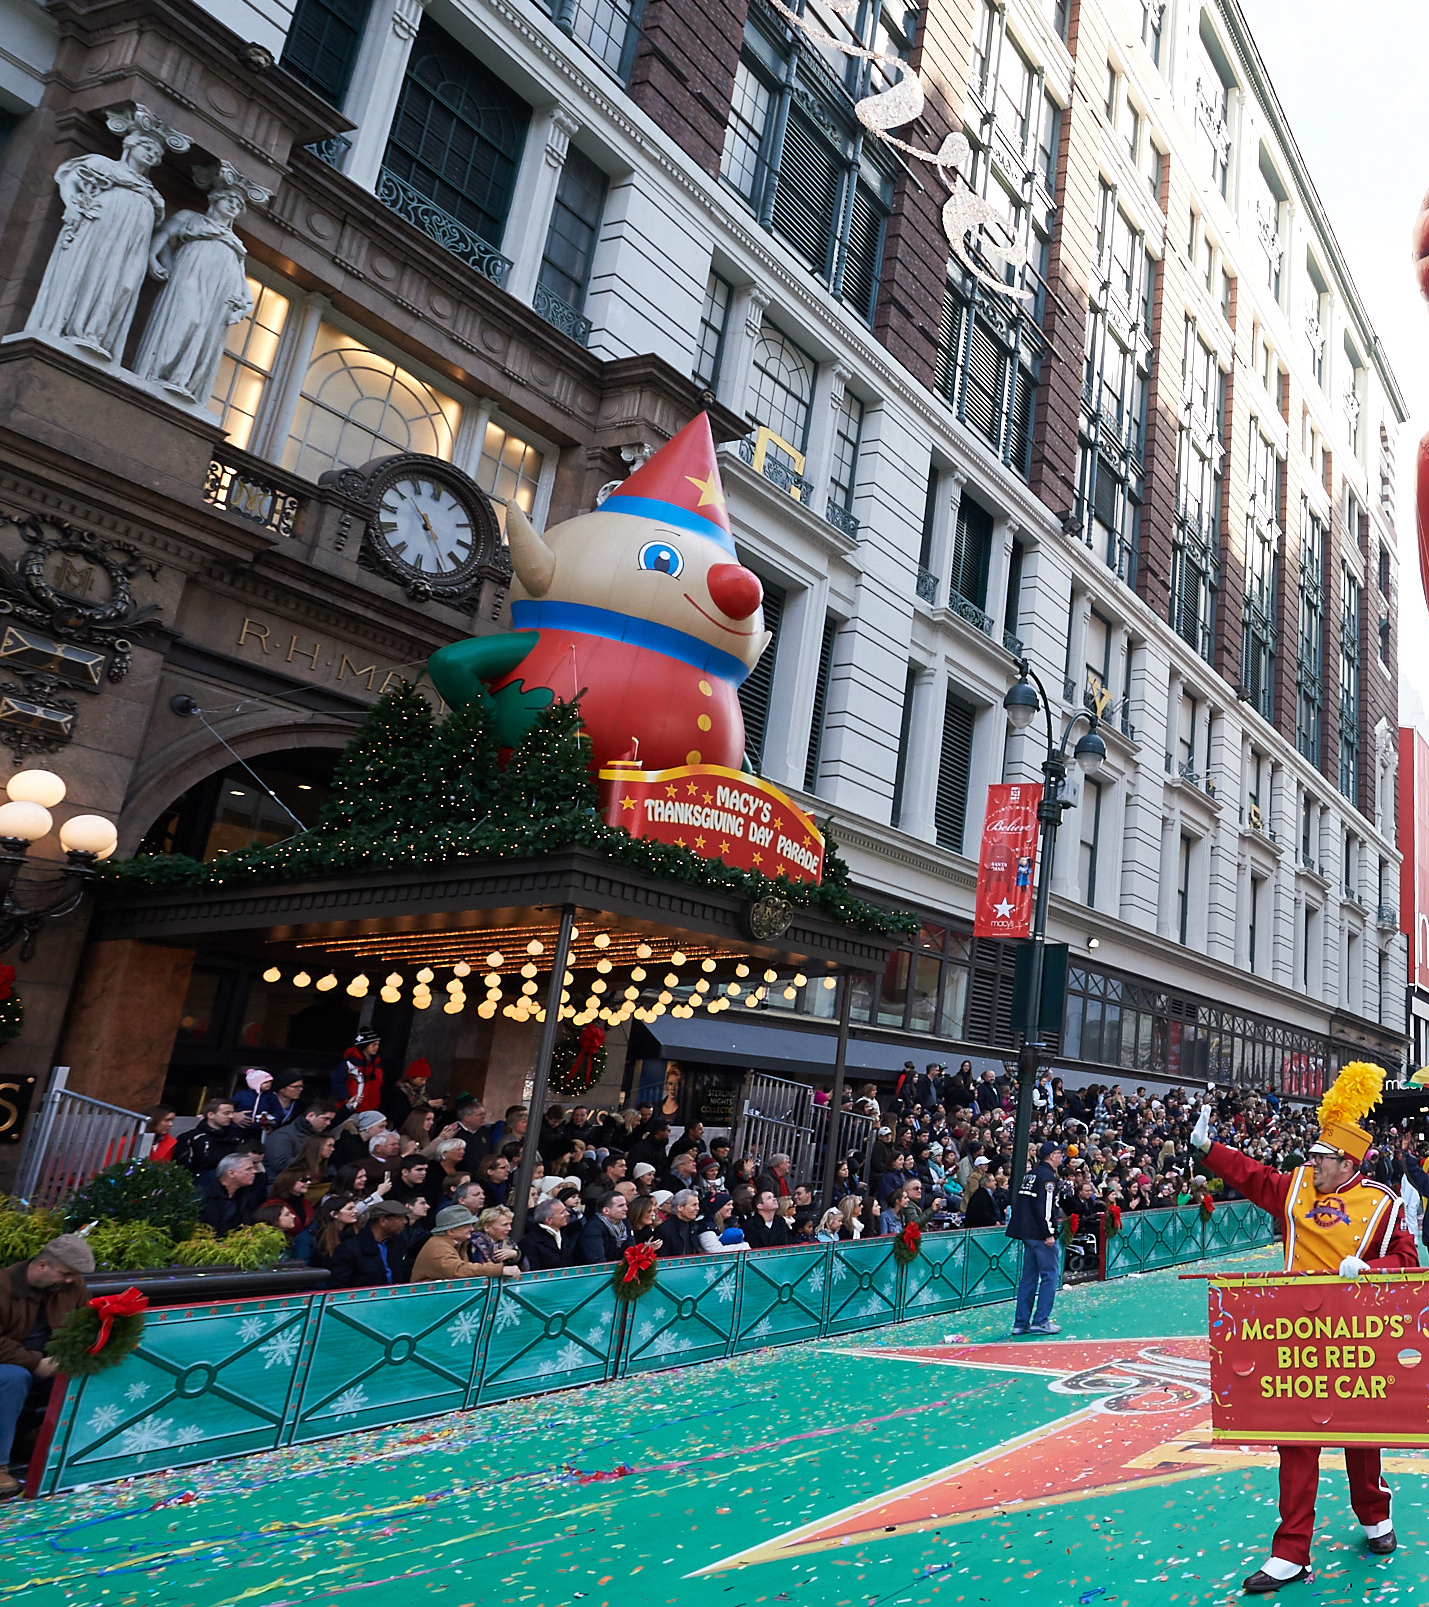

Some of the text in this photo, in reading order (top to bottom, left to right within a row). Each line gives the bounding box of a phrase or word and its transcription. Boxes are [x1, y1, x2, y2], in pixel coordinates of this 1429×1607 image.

[716, 785, 772, 823] MACY'S
[644, 798, 820, 876] THANKSGIVING DAY PARADE
[1277, 1345, 1376, 1369] BIG RED
[1260, 1375, 1329, 1399] SHOE
